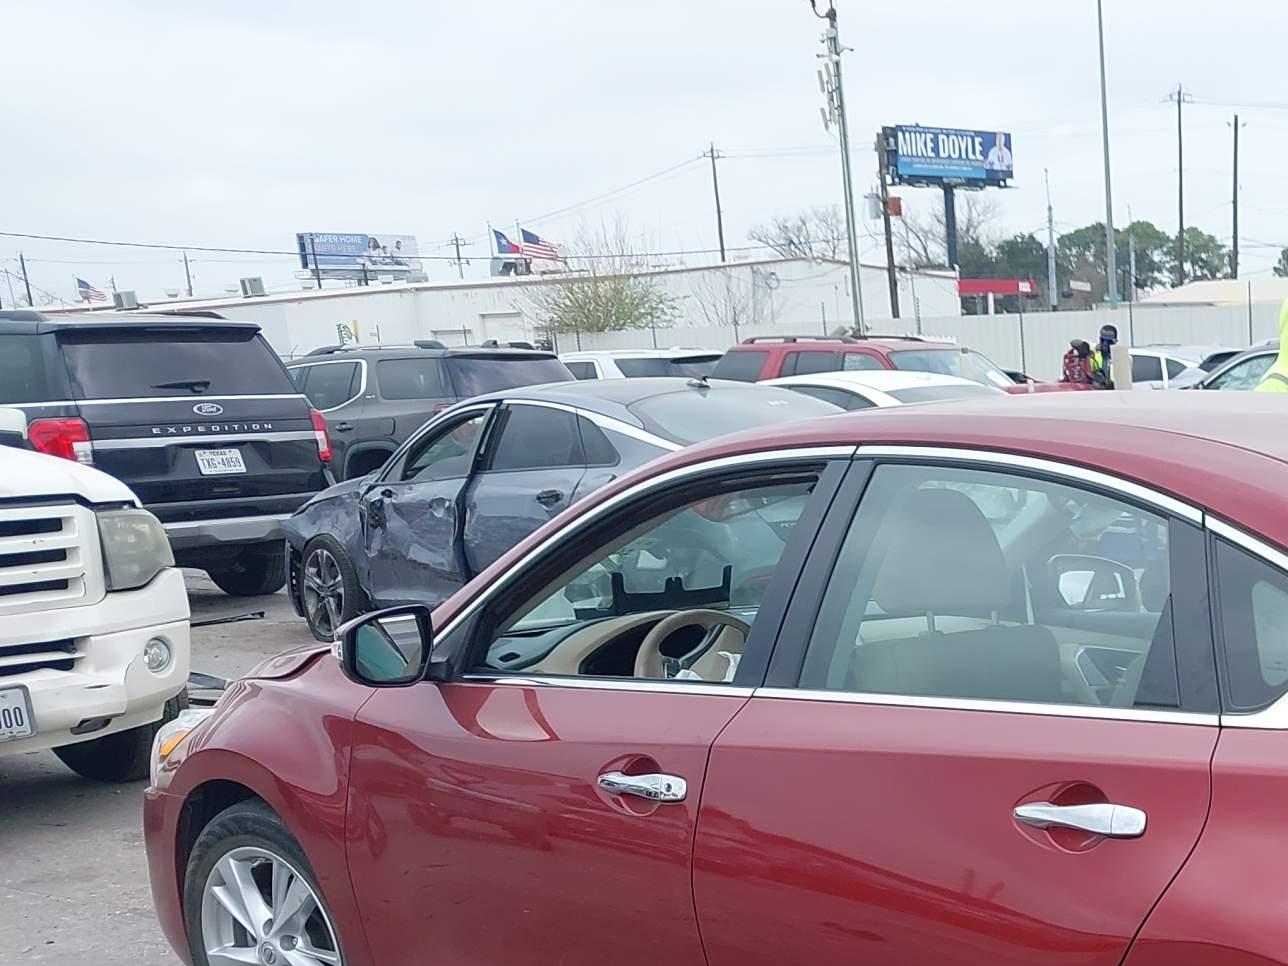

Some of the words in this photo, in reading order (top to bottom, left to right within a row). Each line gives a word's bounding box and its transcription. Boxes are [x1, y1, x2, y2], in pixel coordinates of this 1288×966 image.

[897, 131, 936, 158] MIKE
[938, 133, 985, 161] DOYLE
[339, 235, 363, 244] HOME
[201, 405, 218, 413] Ford
[152, 423, 273, 434] EXPEDITION
[0, 706, 24, 729] 00
